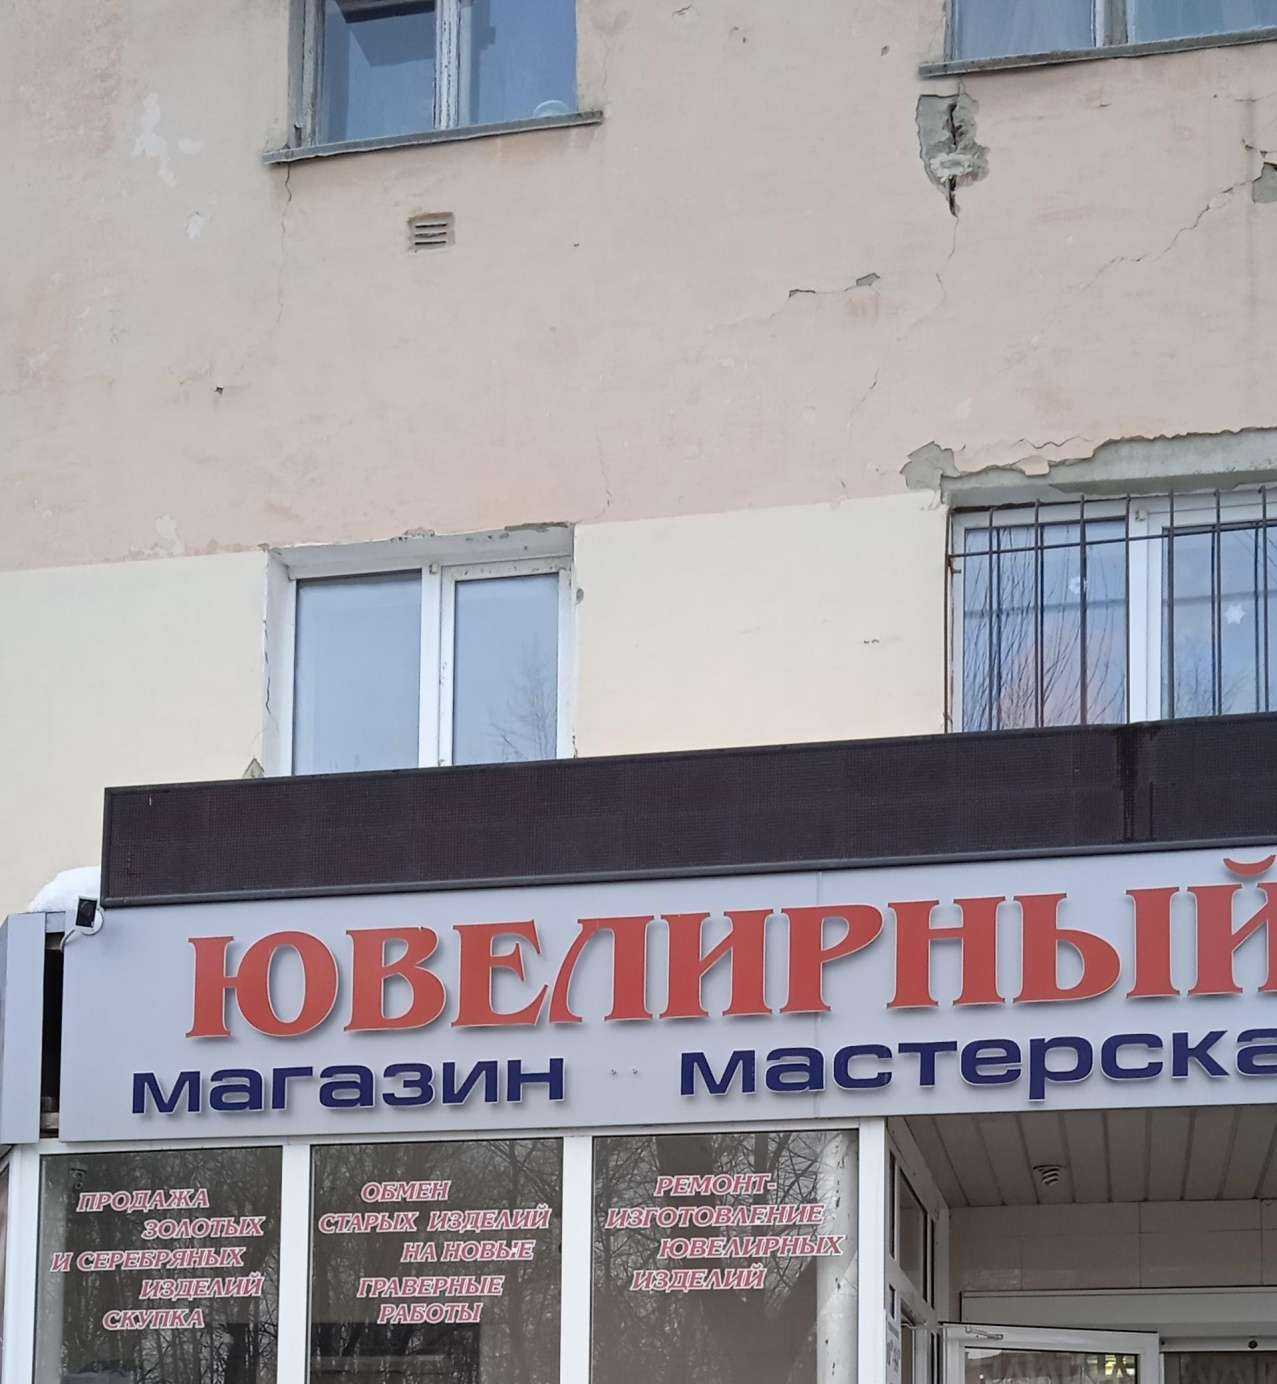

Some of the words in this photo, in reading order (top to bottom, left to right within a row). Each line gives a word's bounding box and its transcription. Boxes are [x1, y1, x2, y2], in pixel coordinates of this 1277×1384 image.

[185, 854, 1277, 1039] ЮВЕЛИРНЫЙ
[132, 1058, 565, 1116] магазин
[679, 1028, 1277, 1102] мастерска
[361, 1180, 451, 1203] ОБМЕН
[654, 1173, 777, 1197] РЕМОНТ-
[76, 1188, 210, 1213] ПРОДАЖА
[141, 1216, 266, 1240] ЗОЛОТЫХ
[318, 1212, 419, 1234] СТАРЫХ
[427, 1203, 552, 1233] ИЗДЕЛИЙ
[605, 1203, 825, 1229] ИЗГОТОВЛЕНИЕ
[401, 1241, 437, 1263] НА
[441, 1239, 537, 1262] НОВЫЕ
[657, 1234, 845, 1259] ЮВЕЛИРНЫХ
[50, 1252, 73, 1272] И
[76, 1247, 247, 1272] СЕРЕБРЯНЫХ
[138, 1271, 265, 1300] ИЗДЕЛИЙ
[356, 1275, 505, 1298] ГРАВЕРНЫЕ
[630, 1263, 767, 1293] ИЗДЕЛИЙ
[102, 1308, 205, 1331] СКУПКА
[377, 1302, 483, 1324] РАБОТЫ
